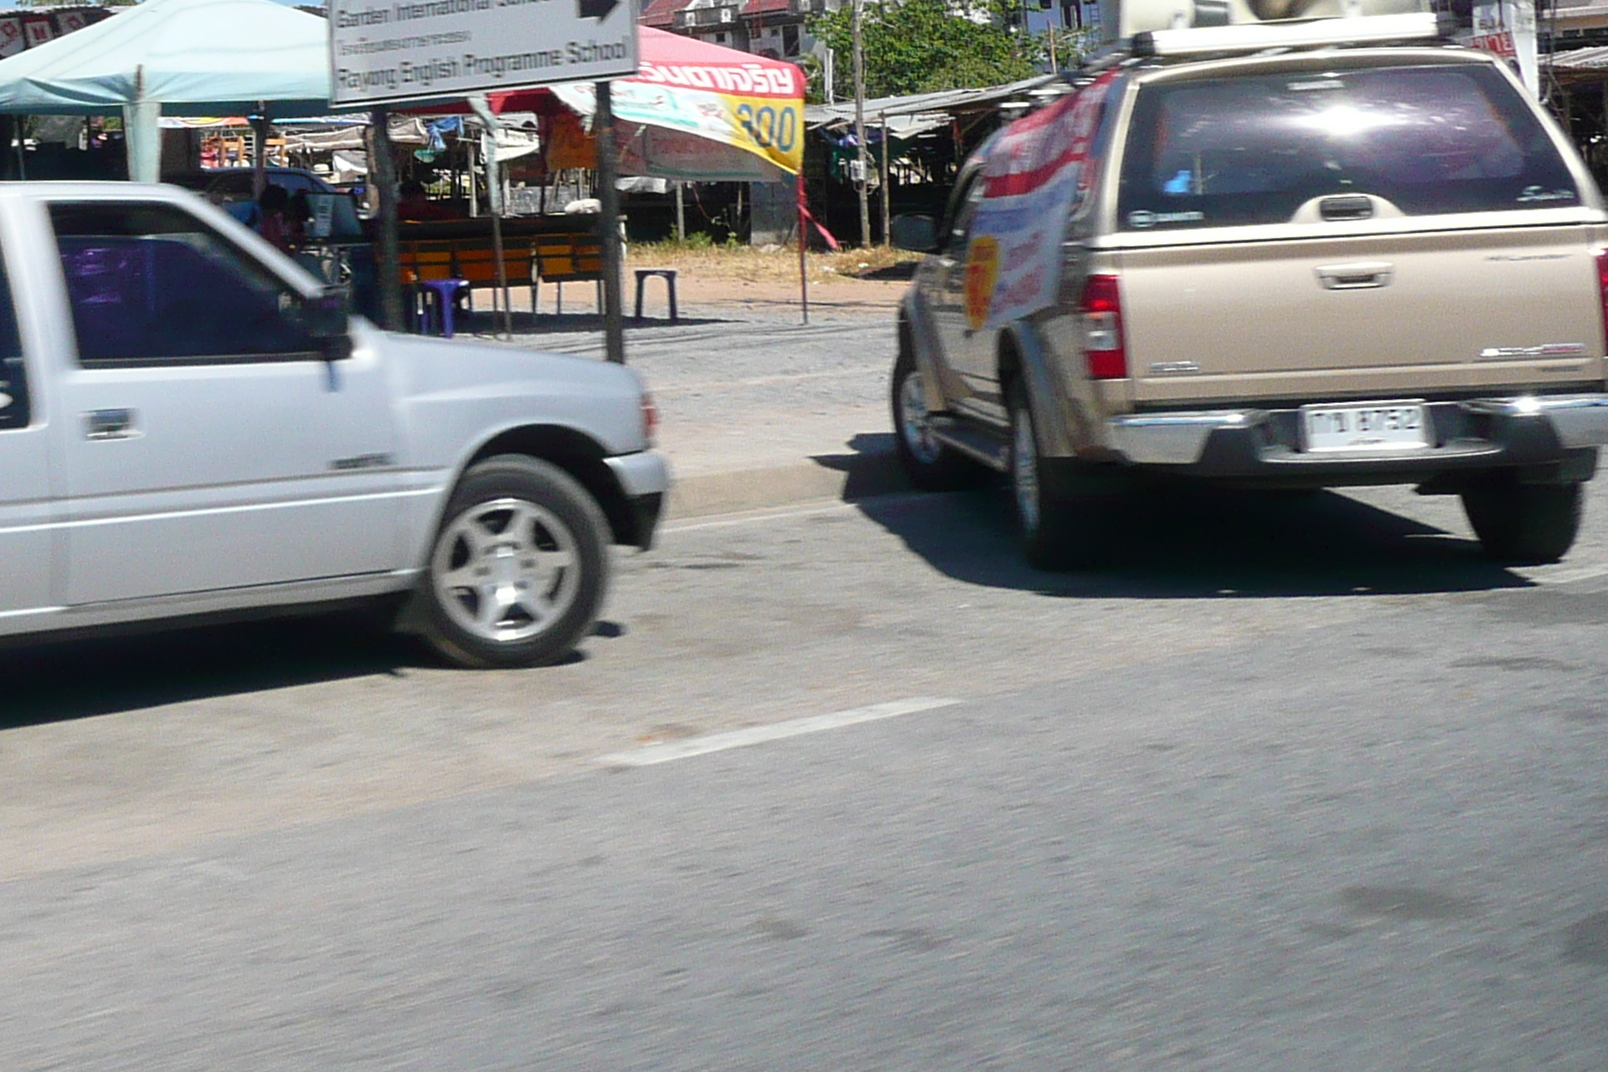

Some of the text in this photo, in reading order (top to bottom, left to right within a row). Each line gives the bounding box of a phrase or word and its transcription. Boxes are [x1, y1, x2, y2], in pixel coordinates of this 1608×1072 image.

[338, 36, 629, 91] Rayong English Programme School
